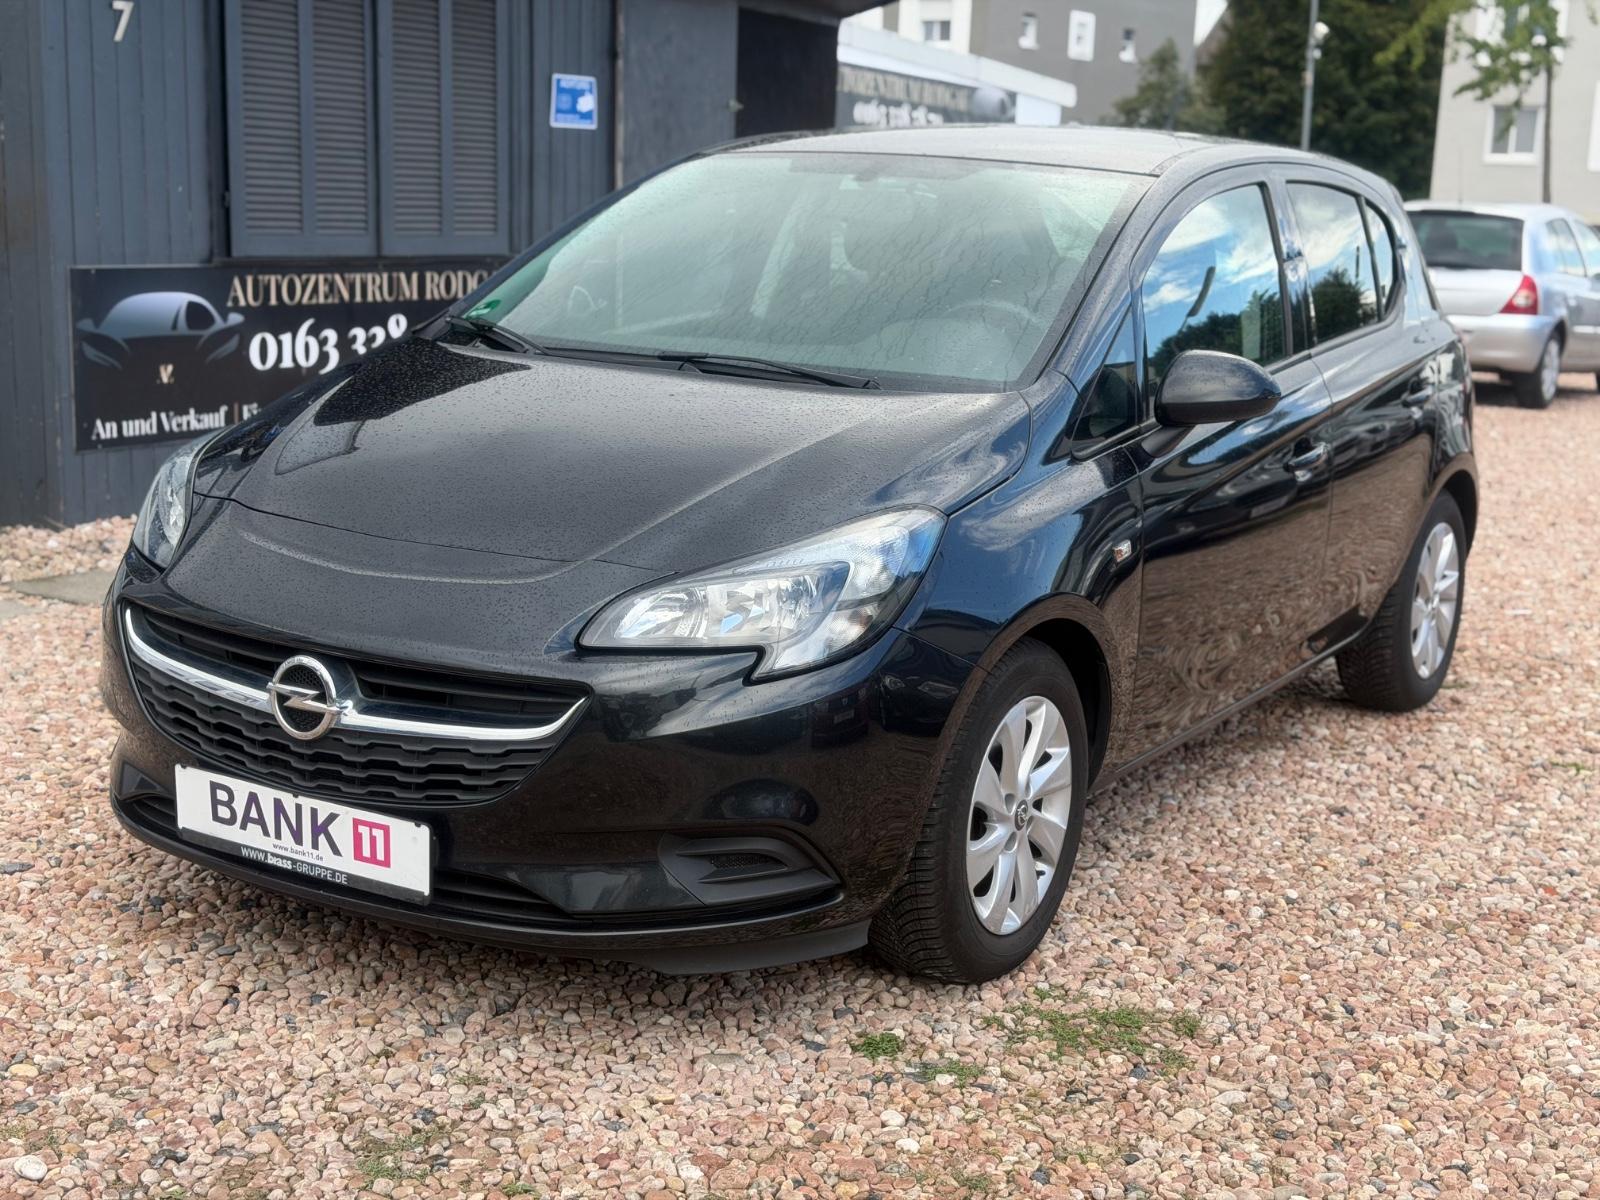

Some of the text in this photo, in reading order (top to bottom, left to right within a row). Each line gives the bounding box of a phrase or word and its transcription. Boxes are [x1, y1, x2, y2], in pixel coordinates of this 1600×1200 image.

[112, 0, 134, 42] 7
[227, 272, 418, 307] AUTOZENTRUM
[249, 318, 340, 375] 0163
[91, 418, 118, 440] An
[121, 411, 158, 437] und
[160, 405, 228, 432] Verkauf
[209, 780, 343, 857] BANK
[272, 842, 324, 862] www.bank11.de
